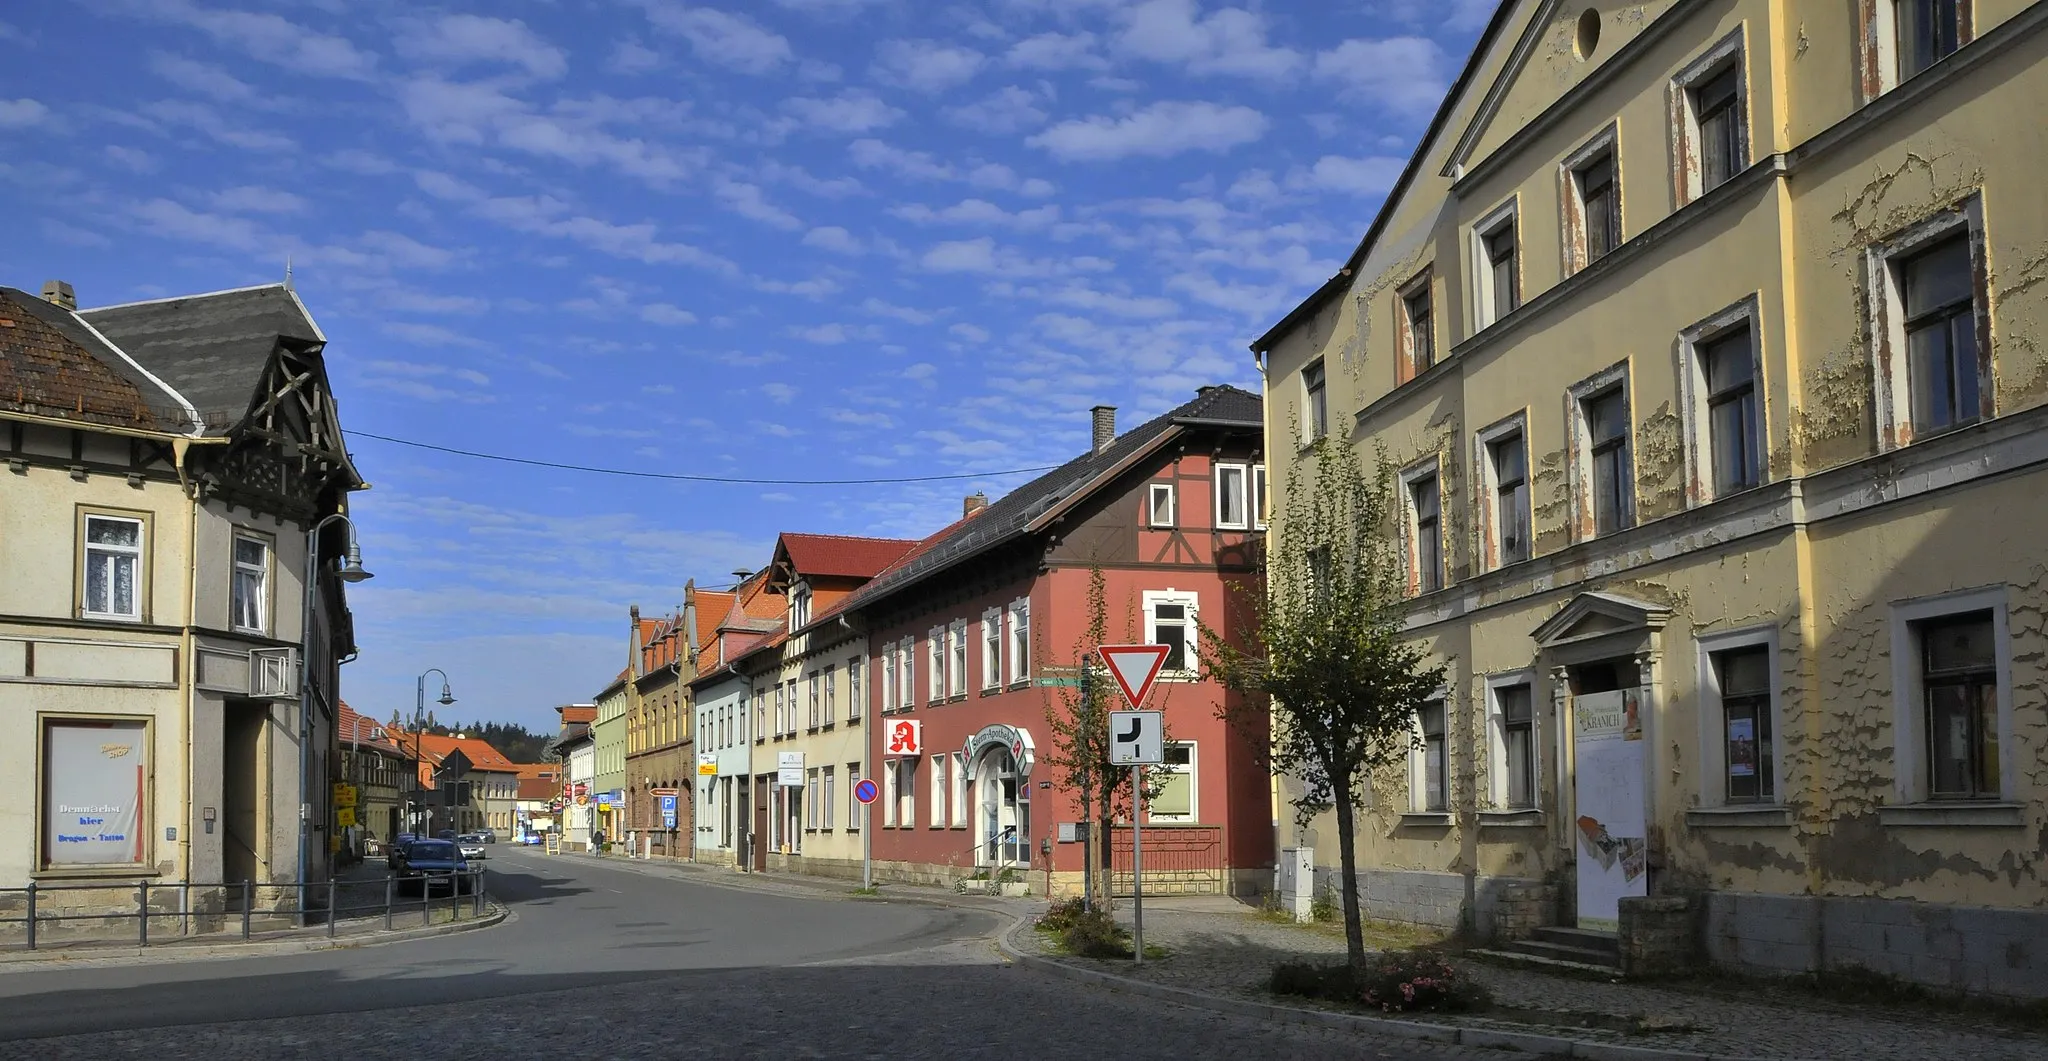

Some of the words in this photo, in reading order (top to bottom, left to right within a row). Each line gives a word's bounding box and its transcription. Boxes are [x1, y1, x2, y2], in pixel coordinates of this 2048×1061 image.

[1586, 713, 1620, 729] KRANICH
[971, 729, 1014, 750] Stern-Apotheke
[664, 798, 673, 808] P
[60, 804, 121, 814] Demnächst
[80, 817, 104, 825] hier
[58, 834, 88, 843] Dragon
